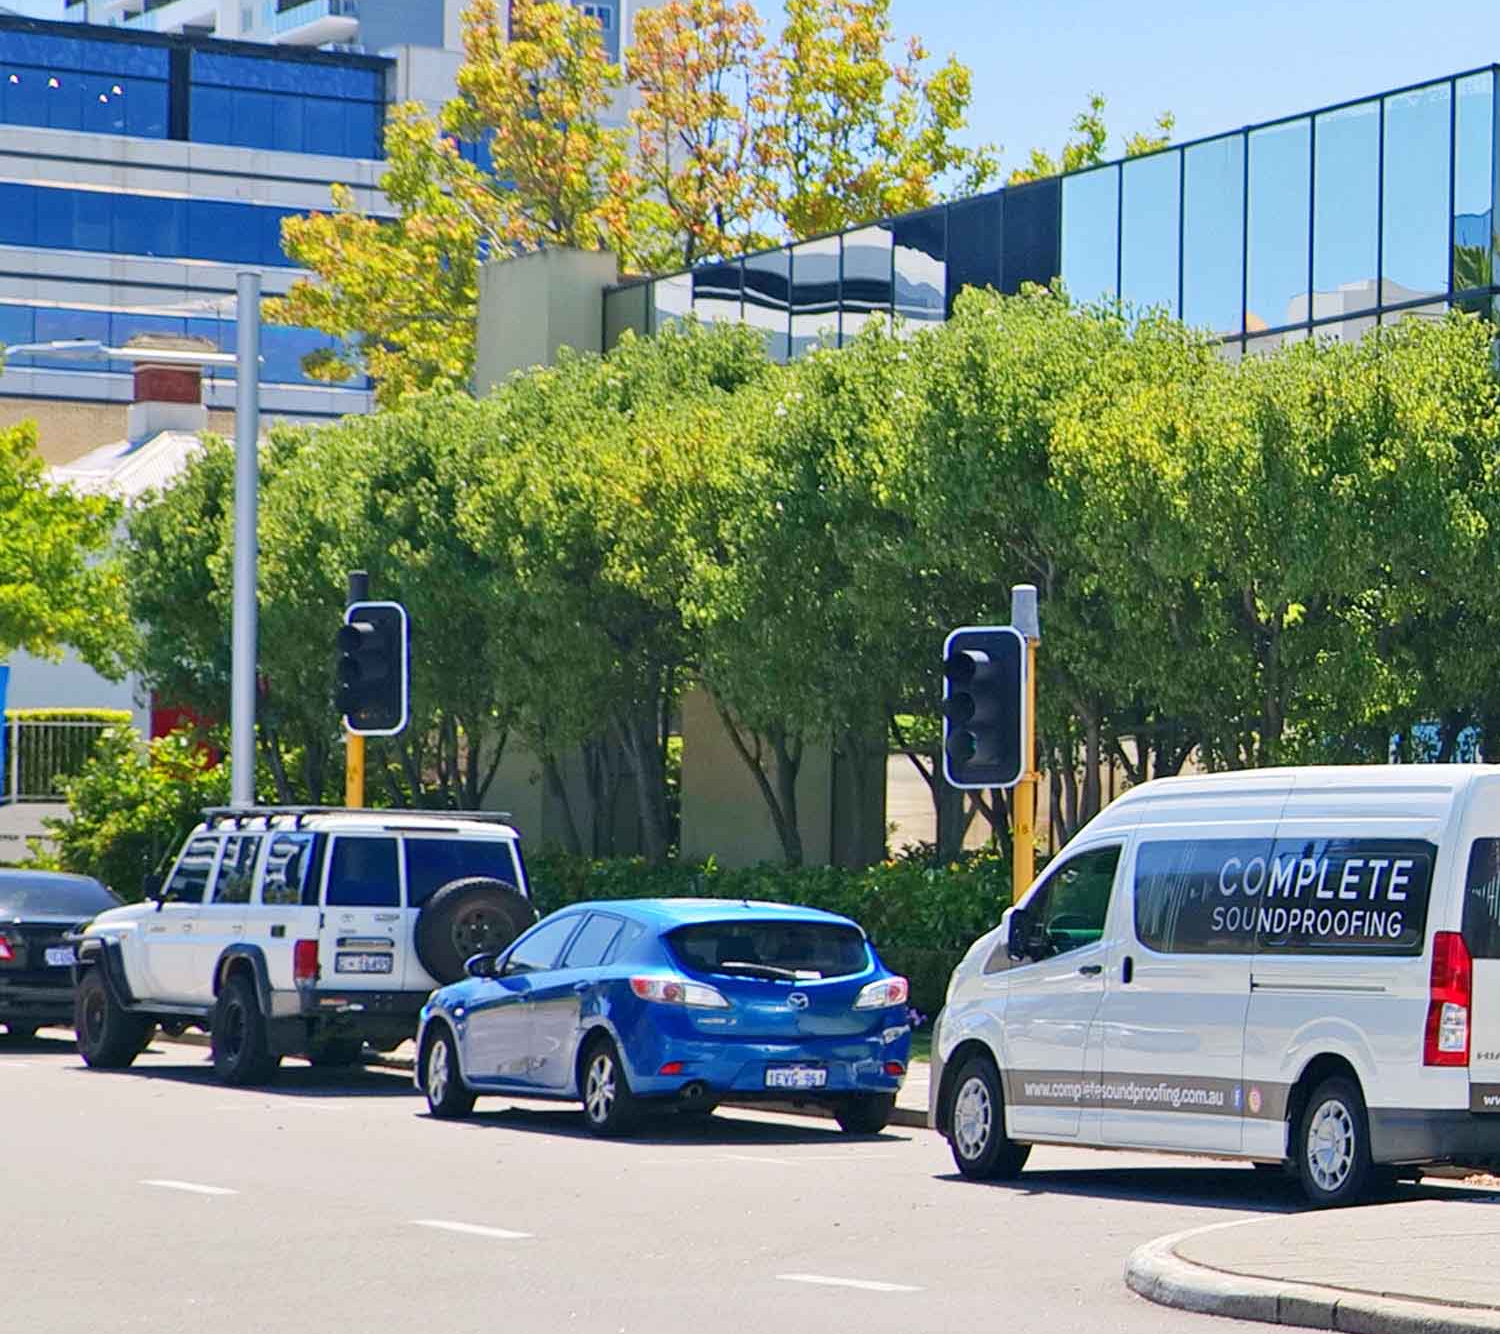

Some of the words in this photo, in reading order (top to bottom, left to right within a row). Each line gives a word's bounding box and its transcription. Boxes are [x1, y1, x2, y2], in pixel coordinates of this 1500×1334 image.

[1218, 856, 1413, 901] COMPLETE
[1211, 906, 1402, 938] SOUNDPROOFING
[1024, 1082, 1224, 1107] www.completesoundproofing.com.au
